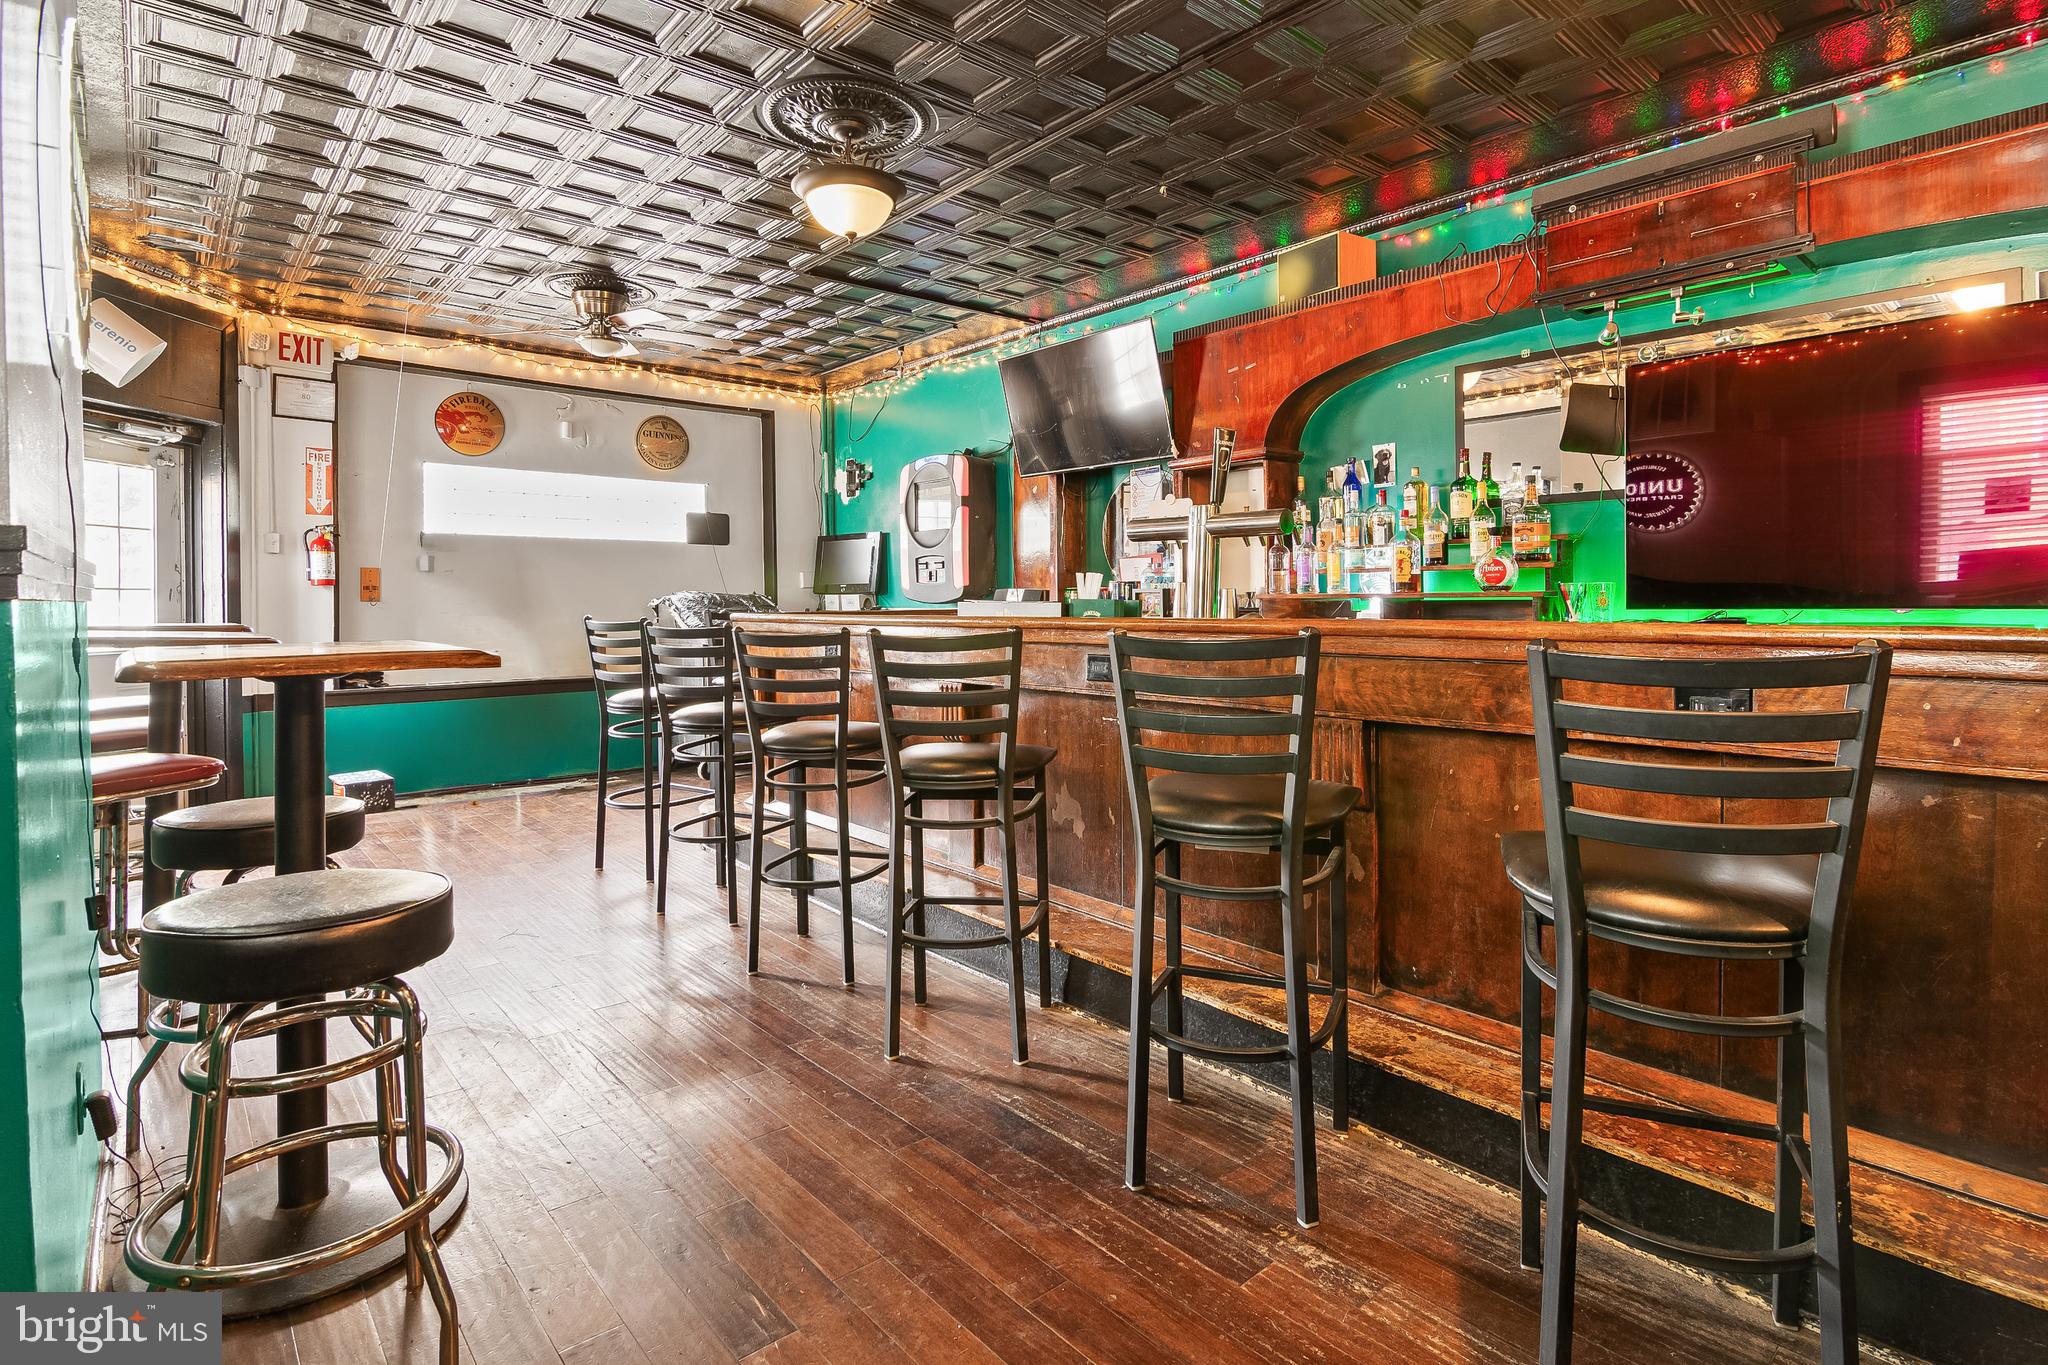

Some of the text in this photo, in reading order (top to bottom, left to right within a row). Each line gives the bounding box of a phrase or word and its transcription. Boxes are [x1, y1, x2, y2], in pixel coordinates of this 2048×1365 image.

[278, 331, 325, 366] EXIT
[449, 395, 497, 415] FIREBALL
[643, 430, 686, 442] GUINNESS
[308, 452, 330, 462] FIRE
